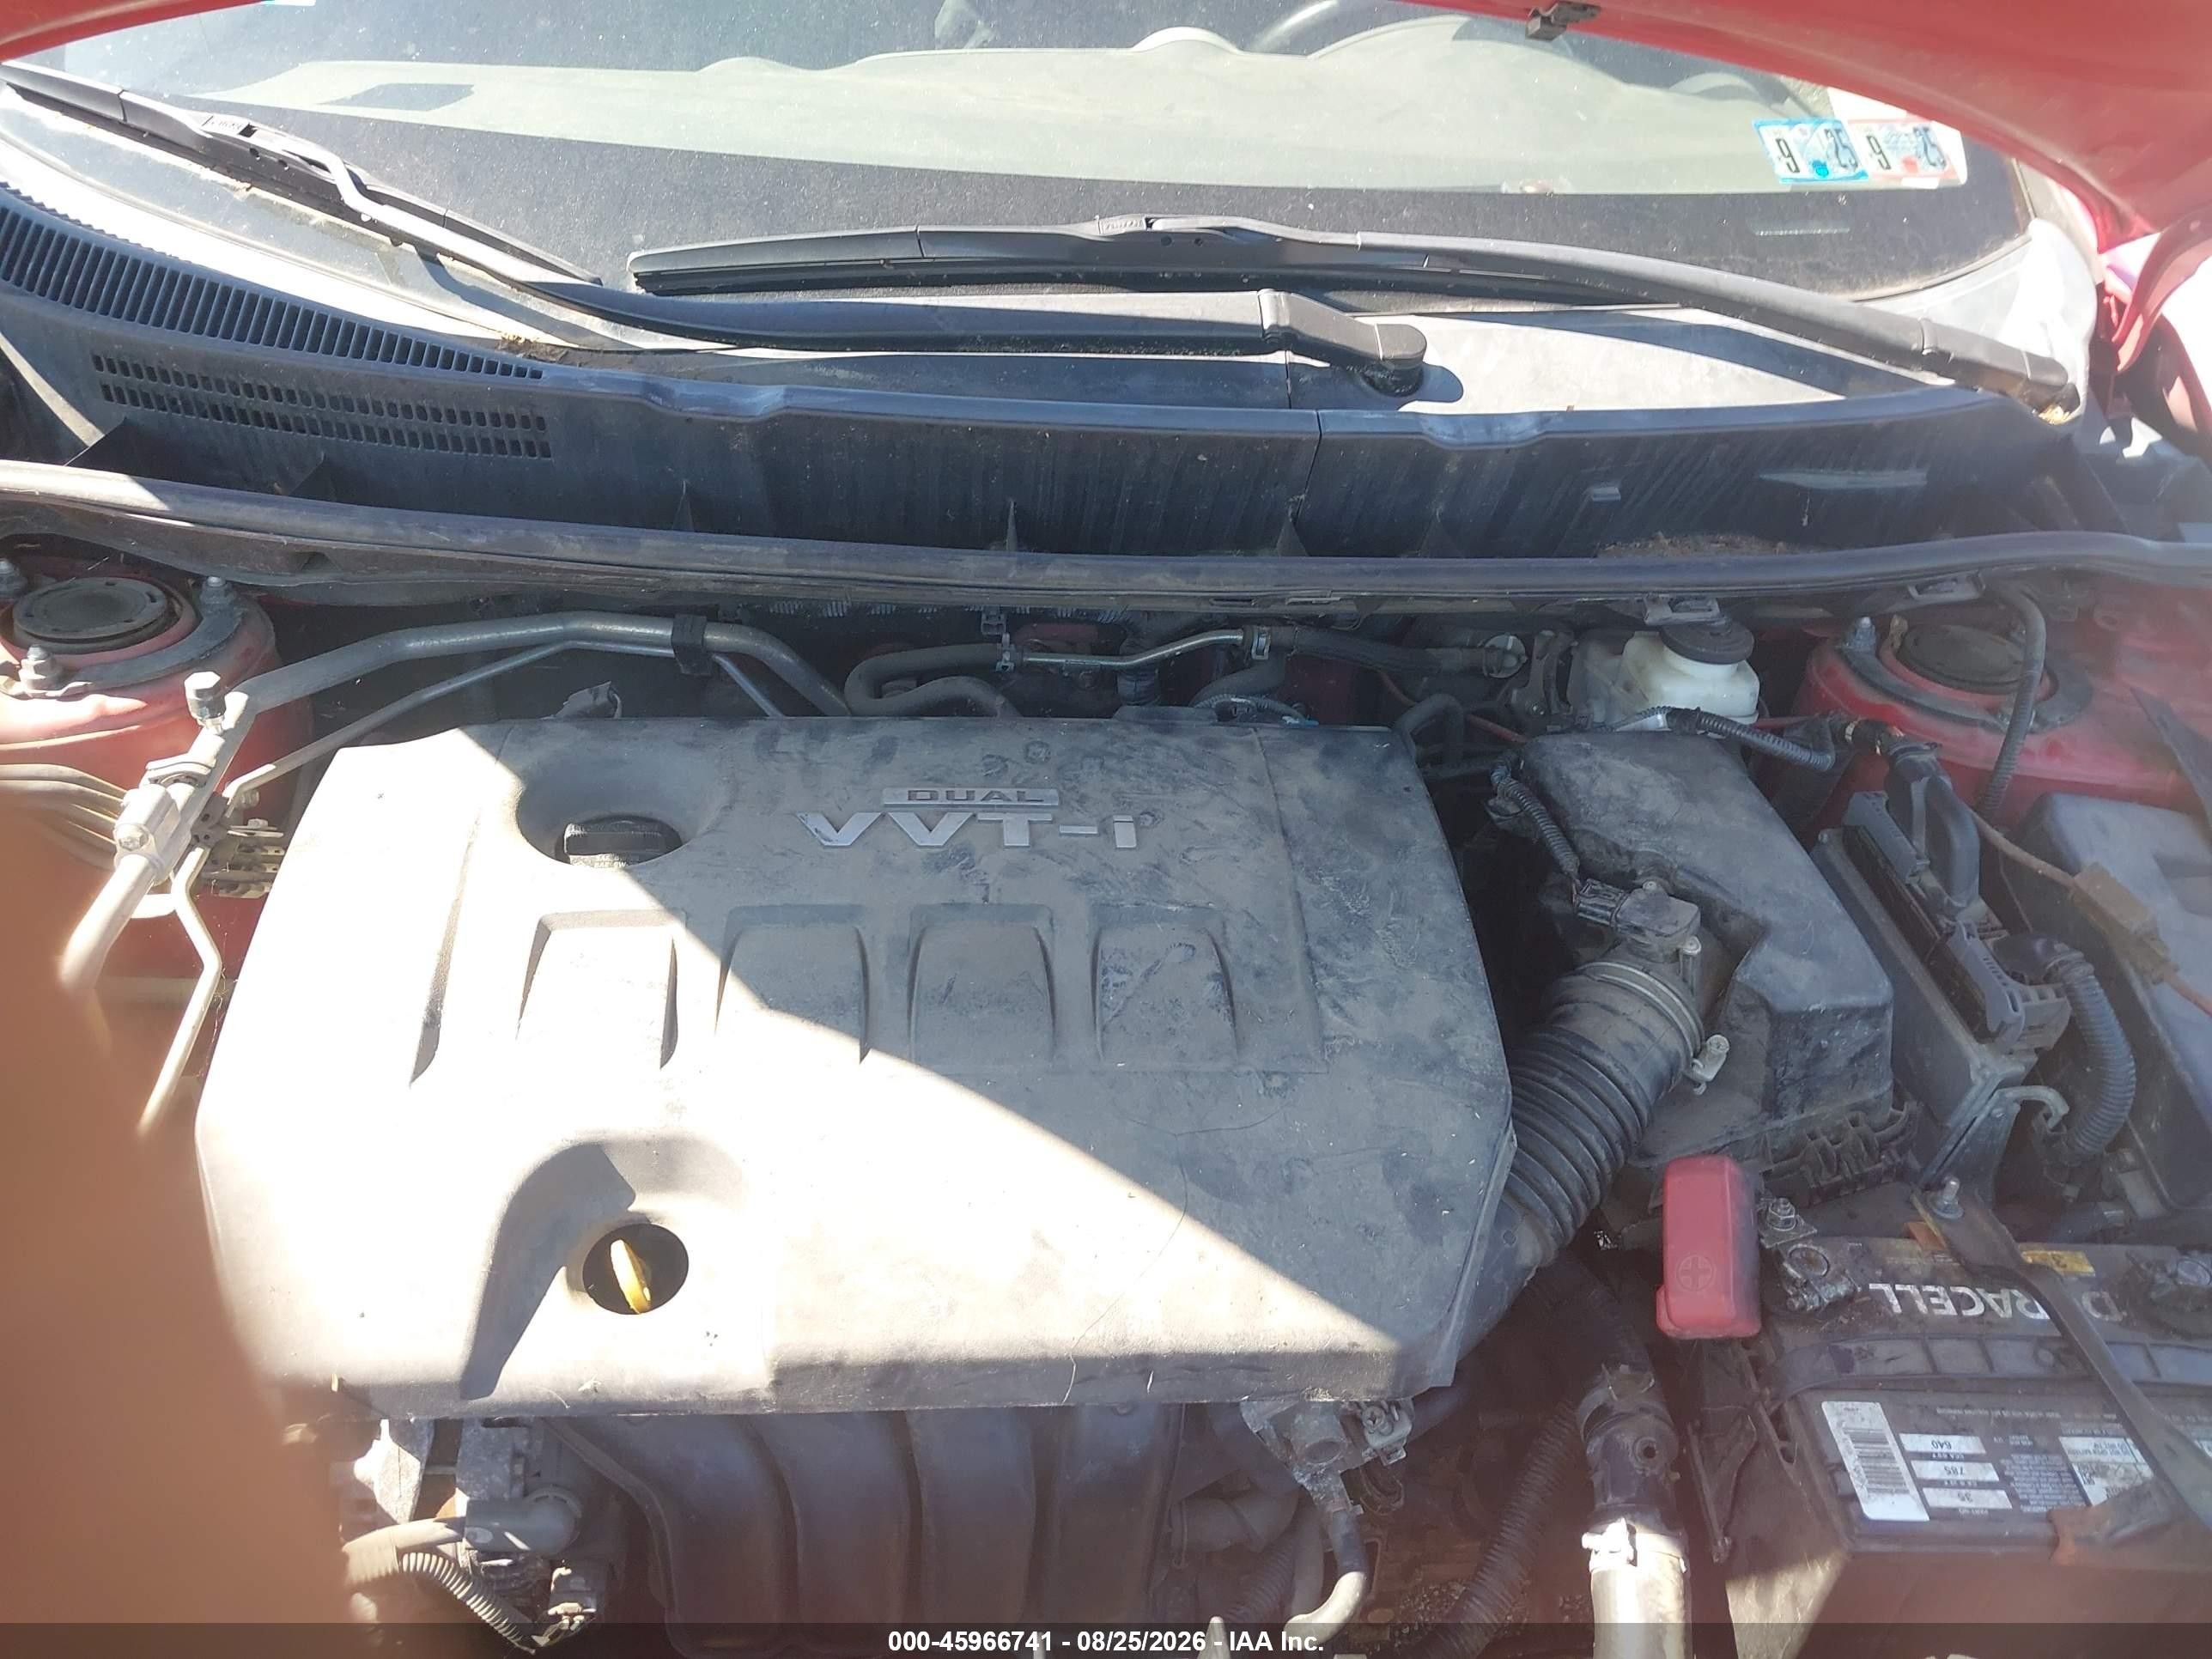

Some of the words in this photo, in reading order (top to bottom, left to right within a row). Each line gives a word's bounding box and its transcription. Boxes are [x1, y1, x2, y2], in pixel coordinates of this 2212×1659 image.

[1776, 137, 1801, 173] 9
[1824, 128, 1858, 170] 25
[1867, 135, 1892, 170] 9
[1913, 125, 1946, 168] 25
[907, 789, 1044, 802] DUAL
[795, 811, 1138, 848] VVT-i
[1869, 1283, 2125, 1322] DRACELL
[1931, 1439, 1952, 1450] 640
